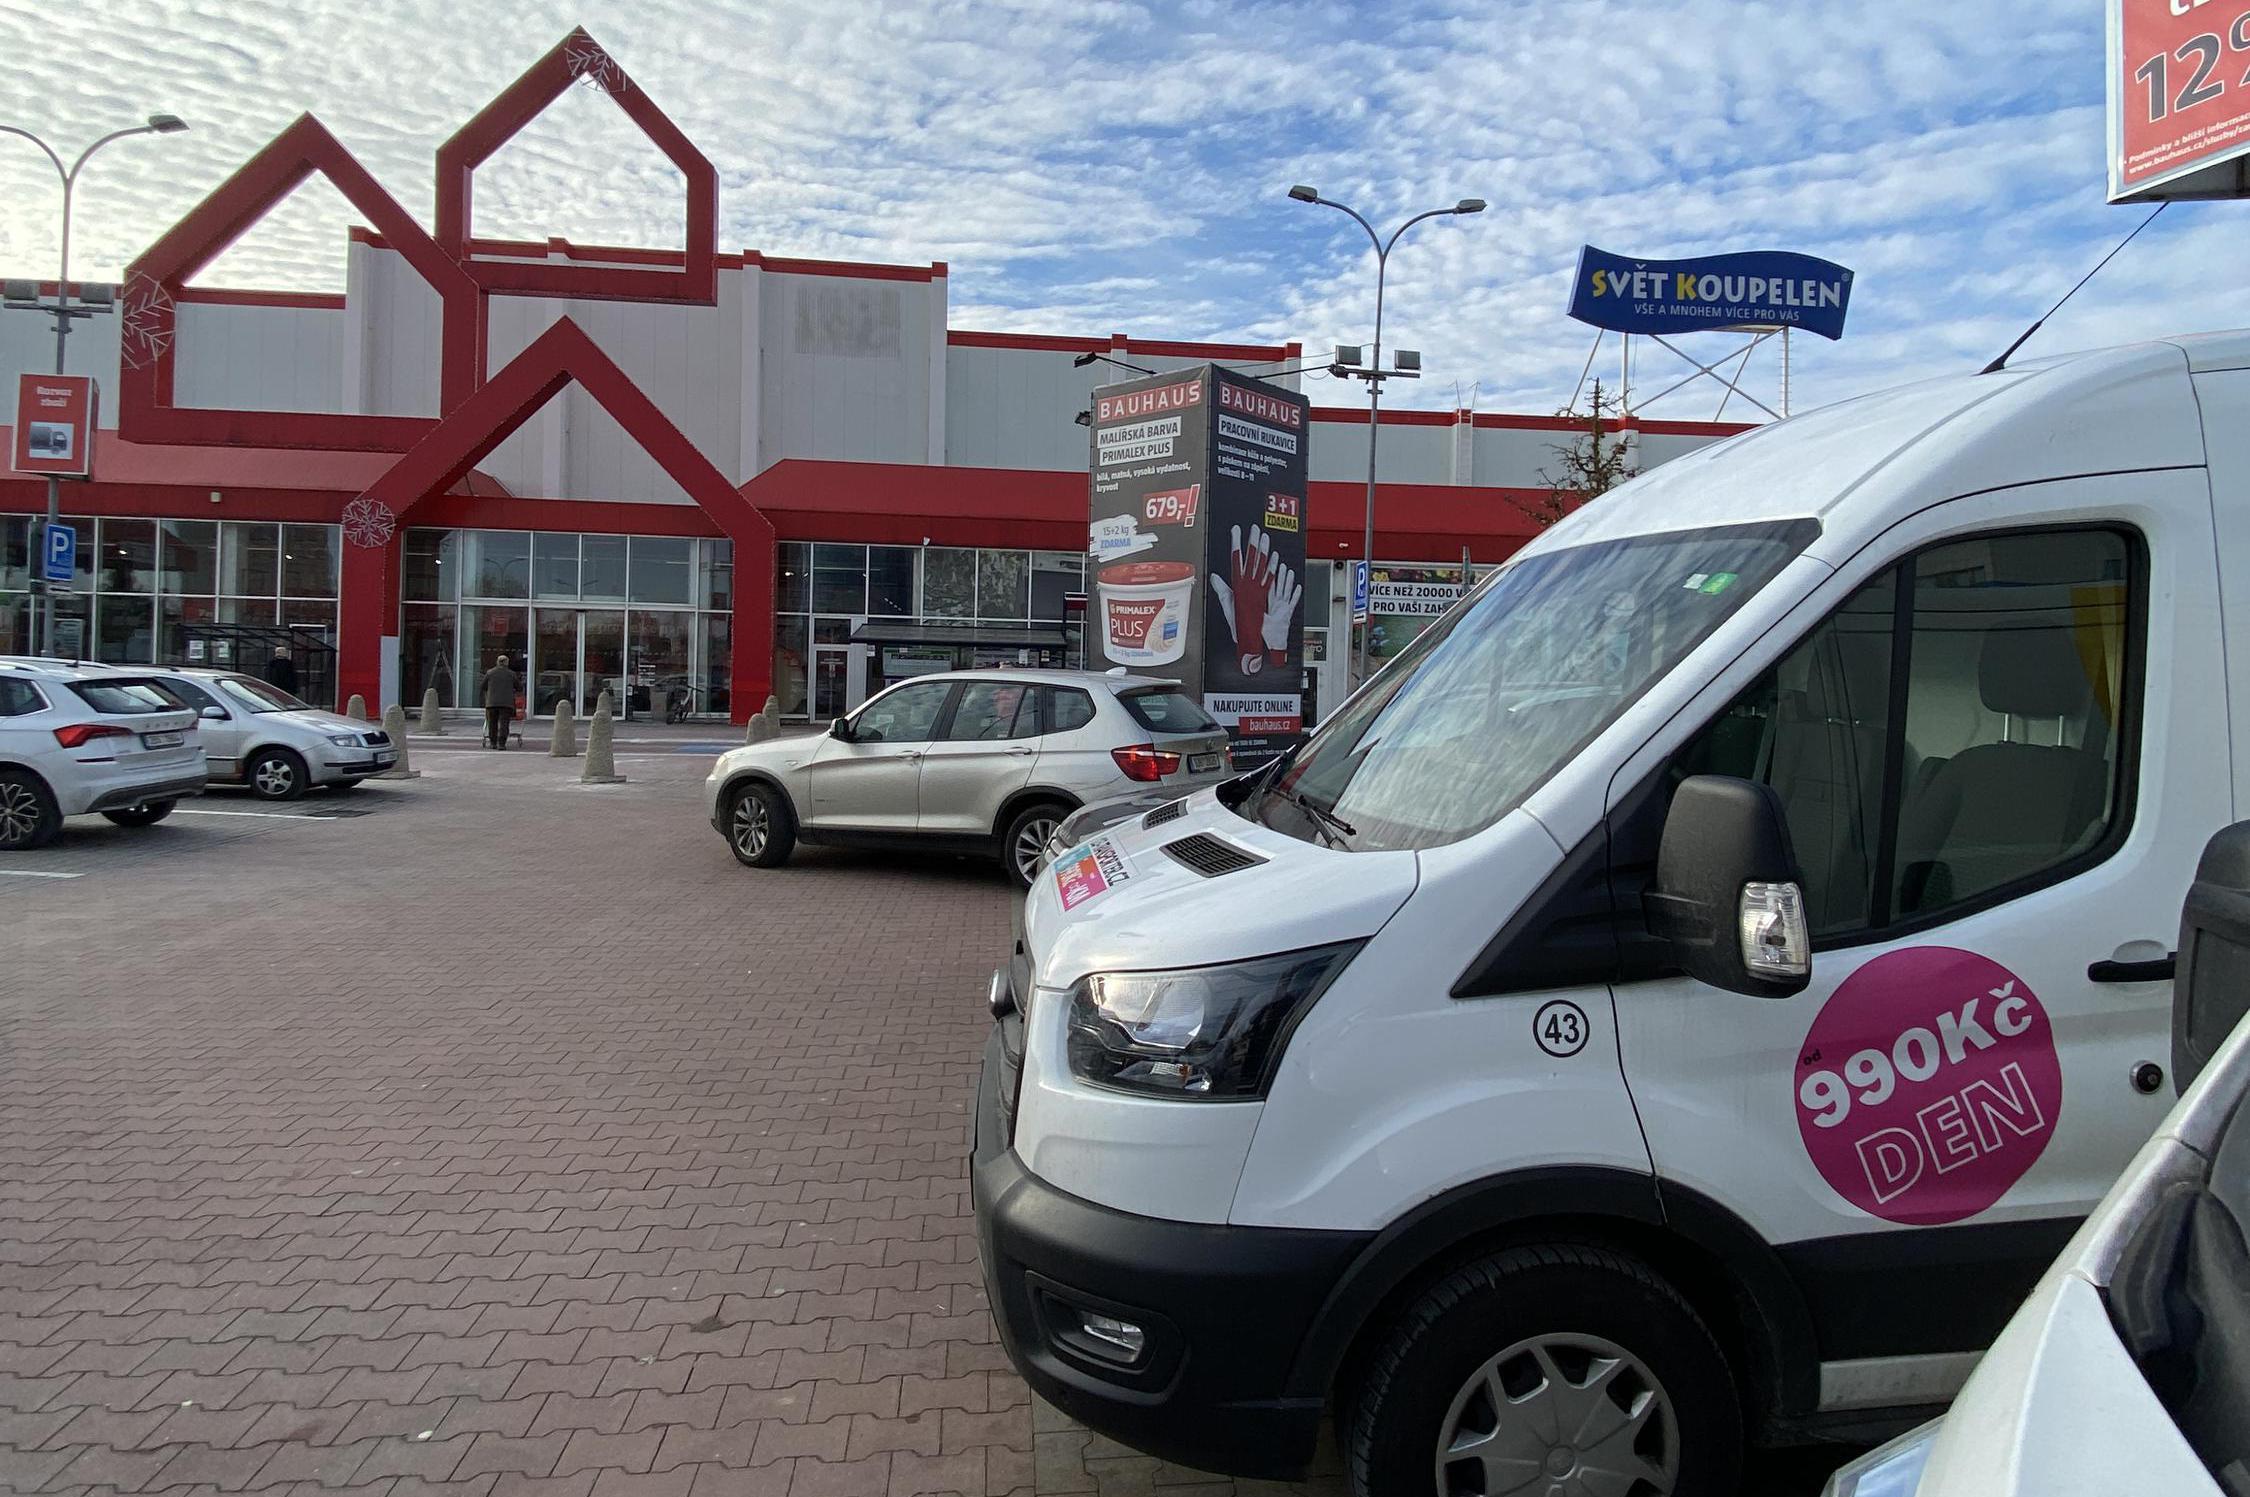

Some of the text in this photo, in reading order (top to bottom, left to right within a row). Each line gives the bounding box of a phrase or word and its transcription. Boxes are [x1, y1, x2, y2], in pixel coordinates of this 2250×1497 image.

[1591, 263, 1841, 308] SVĚT KOUPELEN
[1634, 303, 1800, 322] VŠE A MNOHEM VÍCE PRO VÁS
[1100, 383, 1201, 419] BAUHAUS
[1221, 386, 1300, 426] BAUHAUS
[1147, 422, 1178, 438] BARVA
[1221, 420, 1295, 450] PRACOVNÍ RUKAVICE
[1102, 441, 1171, 462] PRIMALEX PLUS
[1267, 514, 1297, 530] ZDARMA
[1393, 584, 1414, 597] NEŽ
[1416, 586, 1453, 598] 20000
[1115, 605, 1155, 615] PRIMALEX
[1373, 601, 1395, 612] PRO
[1398, 600, 1422, 613] VAŠI
[1110, 618, 1144, 638] PLUS
[1213, 699, 1293, 713] NAKUPUJTE ONLINE
[1249, 718, 1291, 731] bauhaus.cz
[1544, 1012, 1580, 1044] 43
[1803, 1050, 1823, 1066] od
[1854, 1061, 2046, 1205] DEN
